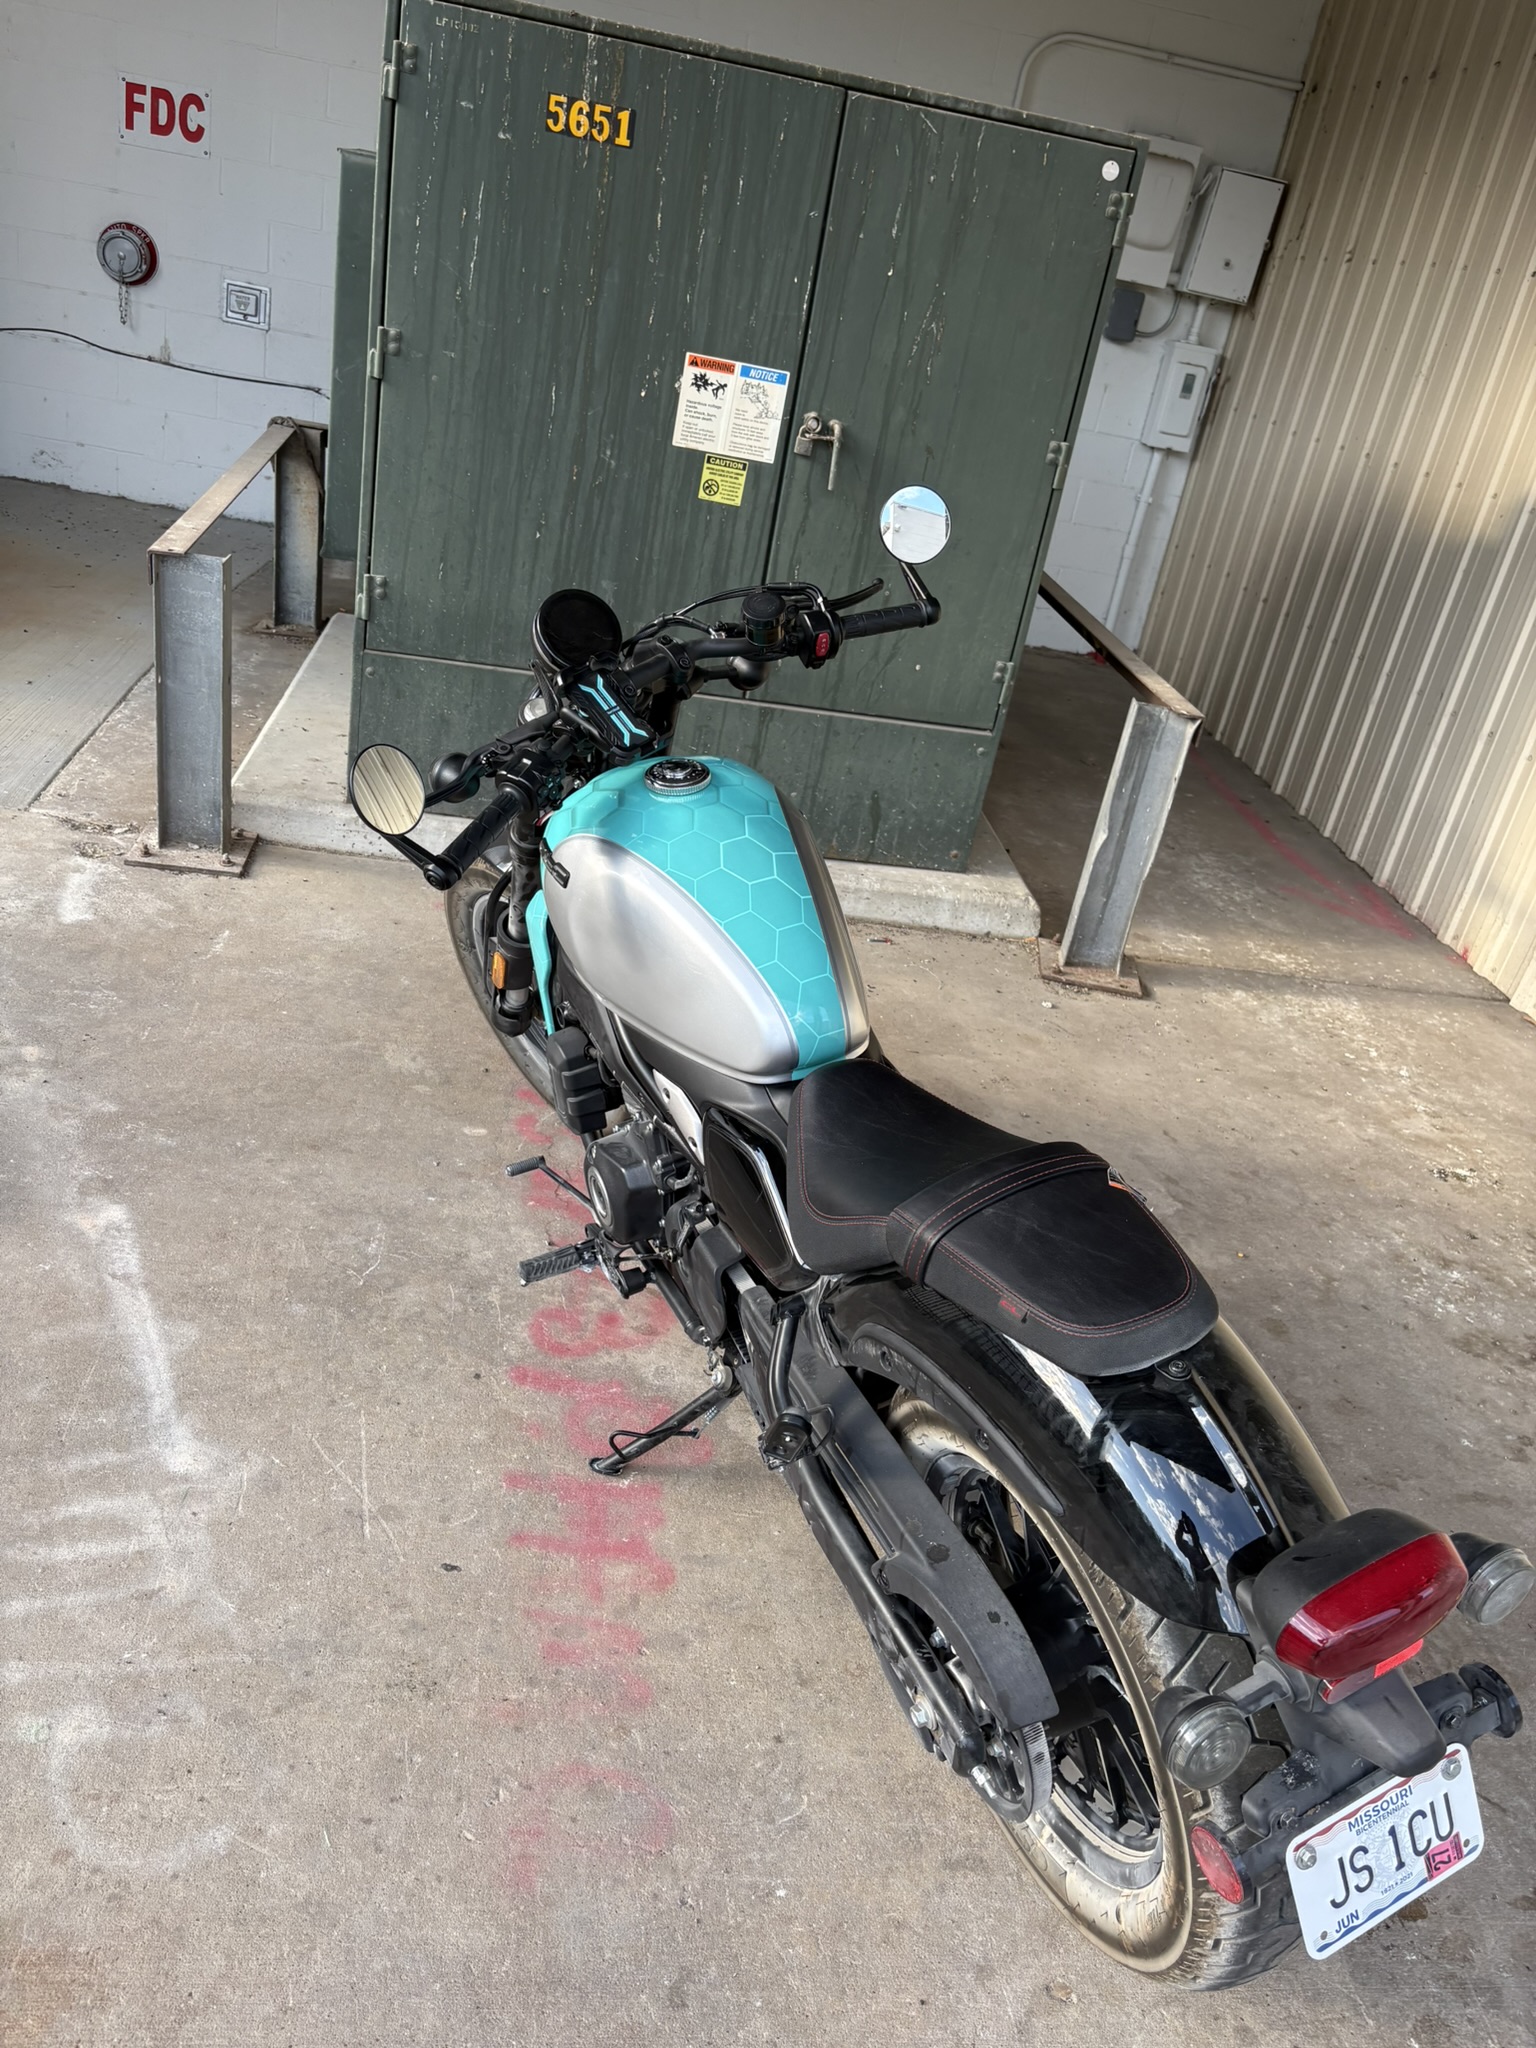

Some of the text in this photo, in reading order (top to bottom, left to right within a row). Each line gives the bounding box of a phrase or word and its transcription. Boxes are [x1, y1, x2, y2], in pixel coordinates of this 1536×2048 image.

[125, 81, 206, 144] FDC
[546, 93, 631, 147] 5651
[700, 358, 736, 373] WARNING
[749, 368, 779, 382] NOTICE
[709, 458, 744, 470] CAUTION
[1348, 1784, 1413, 1832] MISSOURI
[1355, 1800, 1410, 1836] BICENTENNIAL
[1329, 1792, 1455, 1909] JS 1CU
[1431, 1848, 1452, 1871] 27
[1335, 1909, 1360, 1934] JUN
